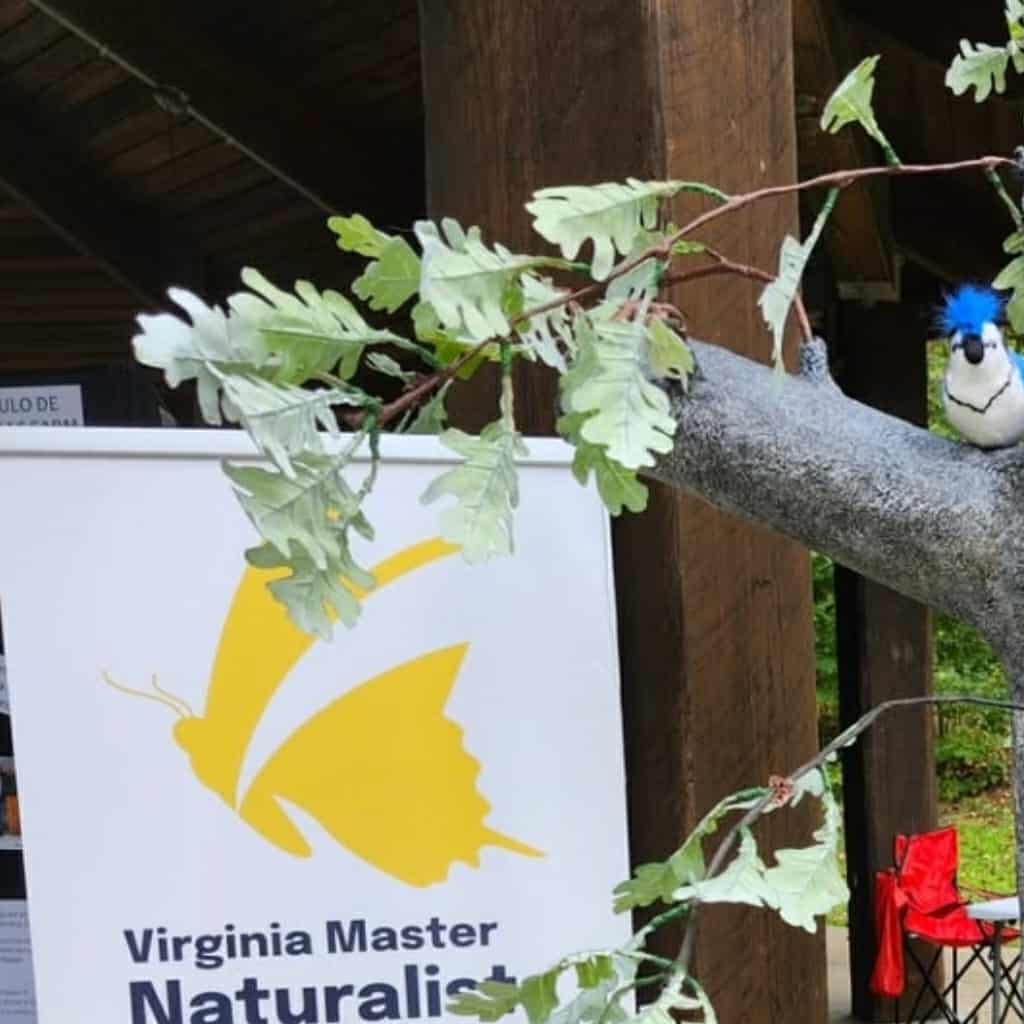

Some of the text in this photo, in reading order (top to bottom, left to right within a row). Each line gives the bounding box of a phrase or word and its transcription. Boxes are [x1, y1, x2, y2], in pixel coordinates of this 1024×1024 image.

[36, 395, 59, 412] DE
[123, 917, 498, 970] Virginia Master
